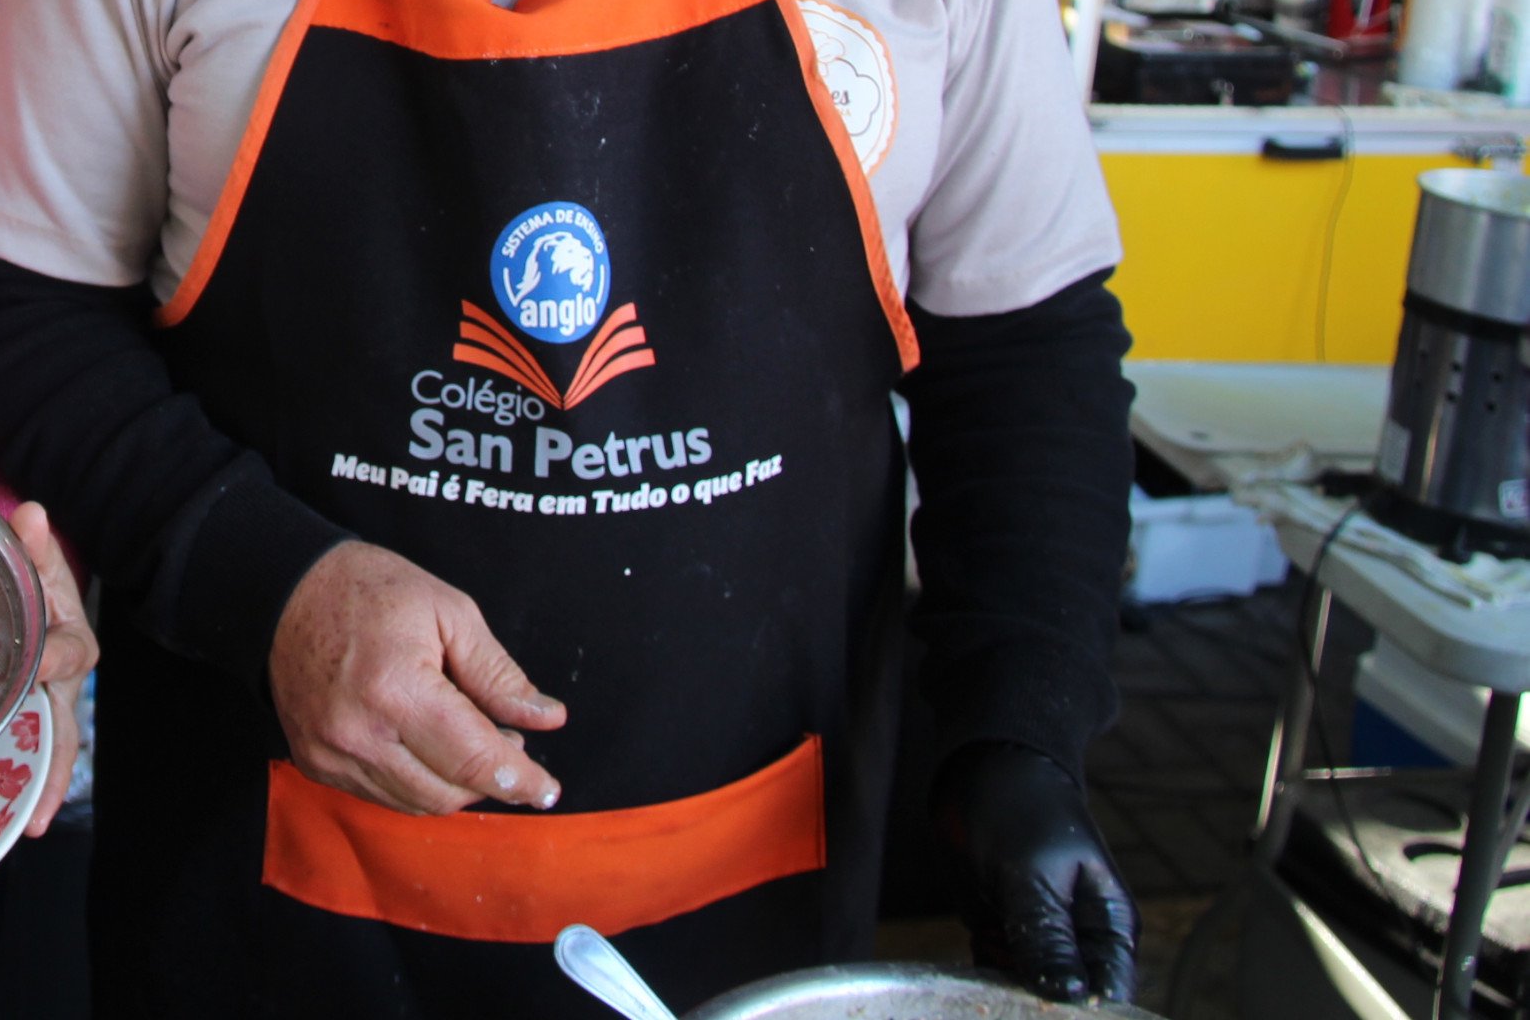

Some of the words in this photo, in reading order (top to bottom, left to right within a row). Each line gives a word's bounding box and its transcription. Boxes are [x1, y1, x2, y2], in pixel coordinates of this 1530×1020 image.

[501, 211, 554, 259] SISTEMA
[555, 209, 574, 224] DE
[574, 211, 605, 254] ENSINO
[519, 291, 596, 336] anglo
[410, 369, 545, 426] Colégio
[408, 407, 513, 474] San
[534, 426, 713, 480] Petrus
[331, 452, 387, 486] Meu
[390, 465, 440, 498] Pai
[441, 474, 461, 501] é
[464, 479, 534, 513] Fera
[538, 493, 587, 515] em
[592, 482, 668, 514] Tudo
[671, 483, 691, 504] o
[693, 471, 743, 505] que
[745, 453, 783, 487] Faz
